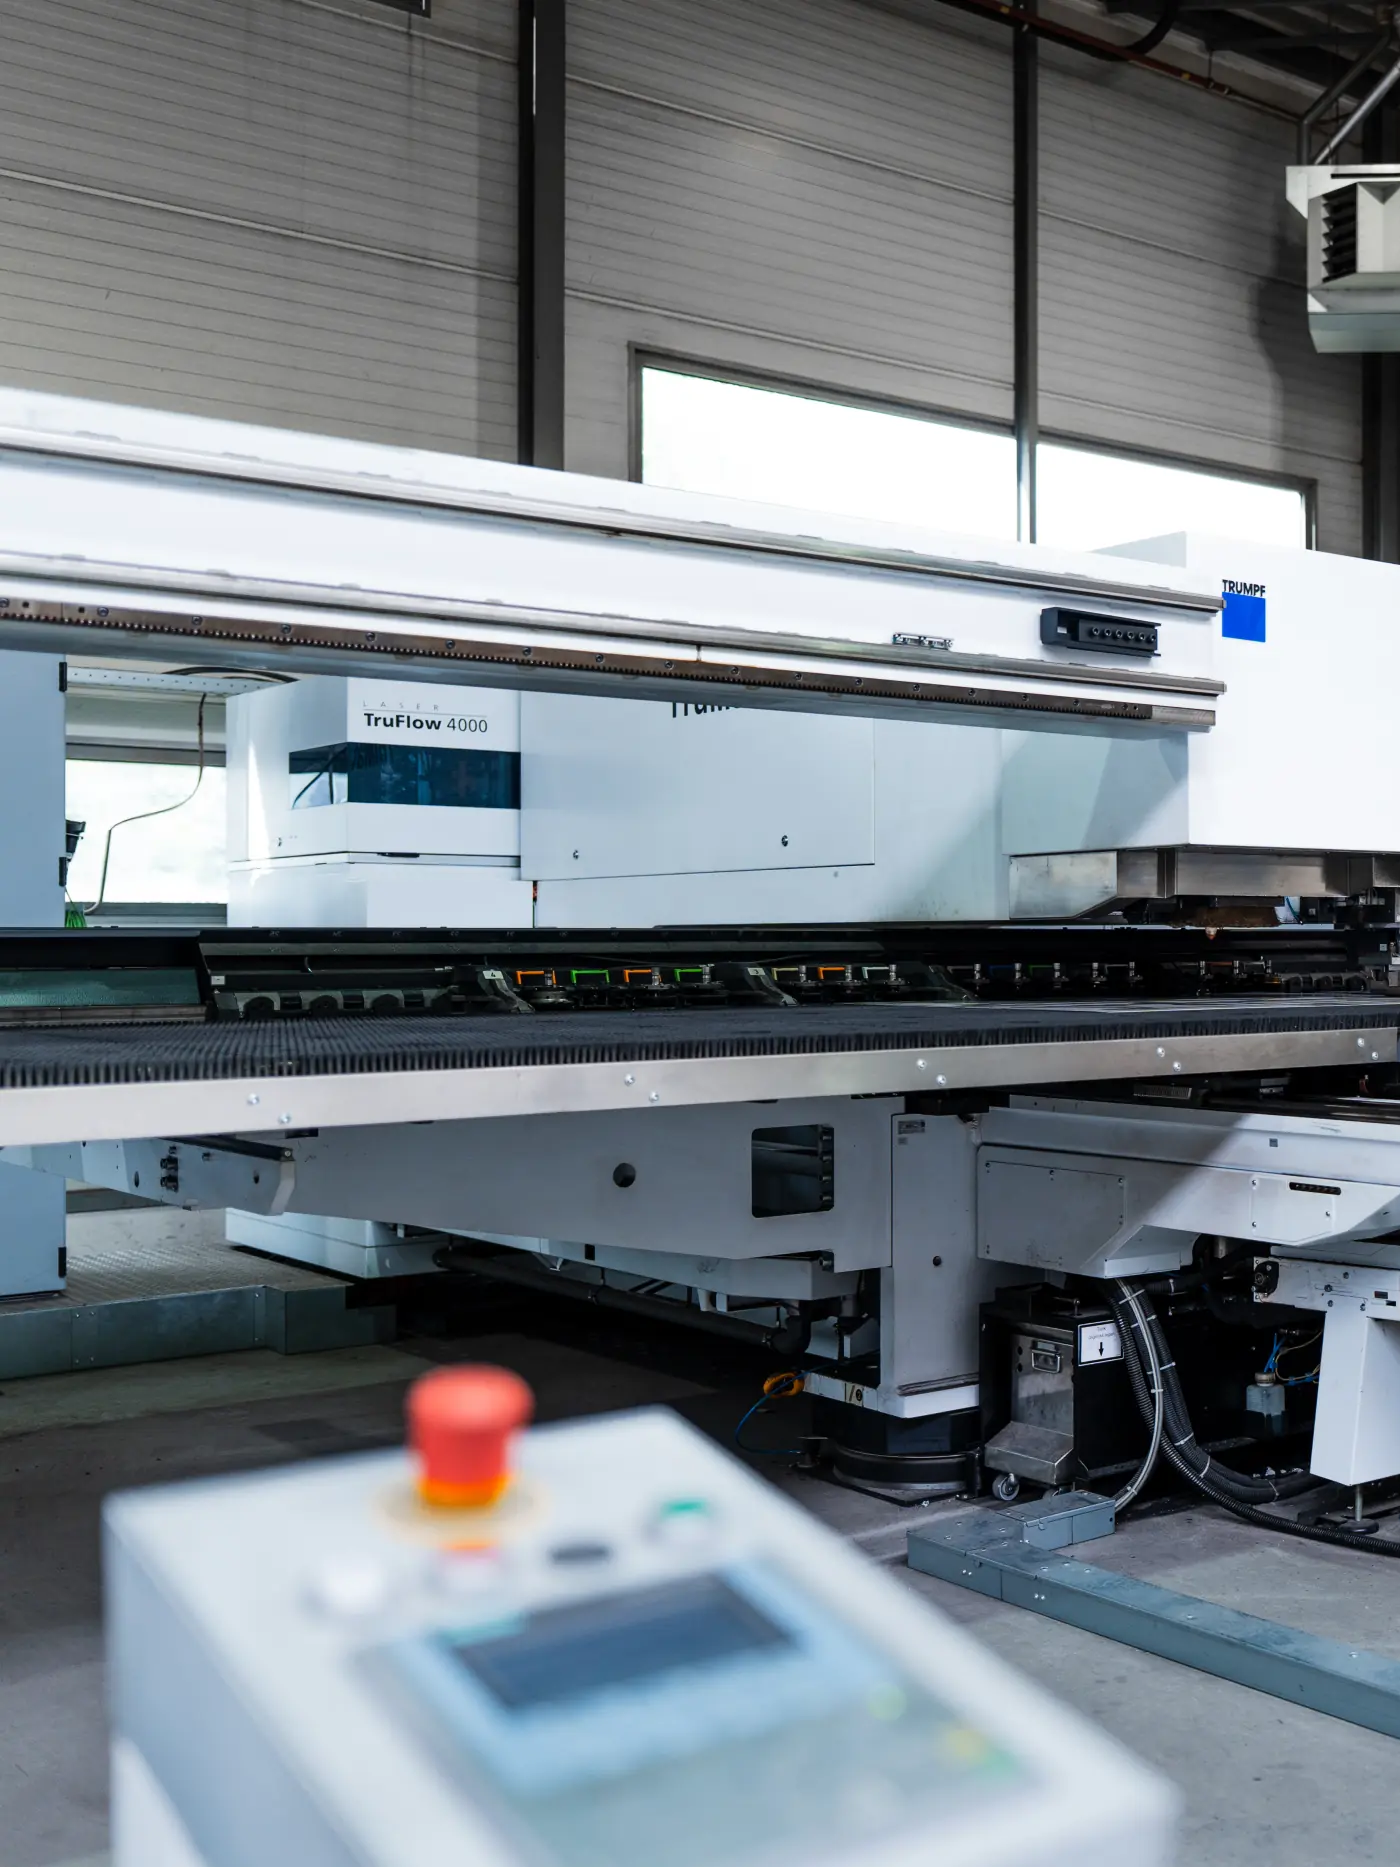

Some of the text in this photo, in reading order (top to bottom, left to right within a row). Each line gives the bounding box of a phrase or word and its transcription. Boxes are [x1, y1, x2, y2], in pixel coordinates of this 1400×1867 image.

[1222, 579, 1266, 597] TRUMPF
[364, 713, 488, 733] TruFlow 4000
